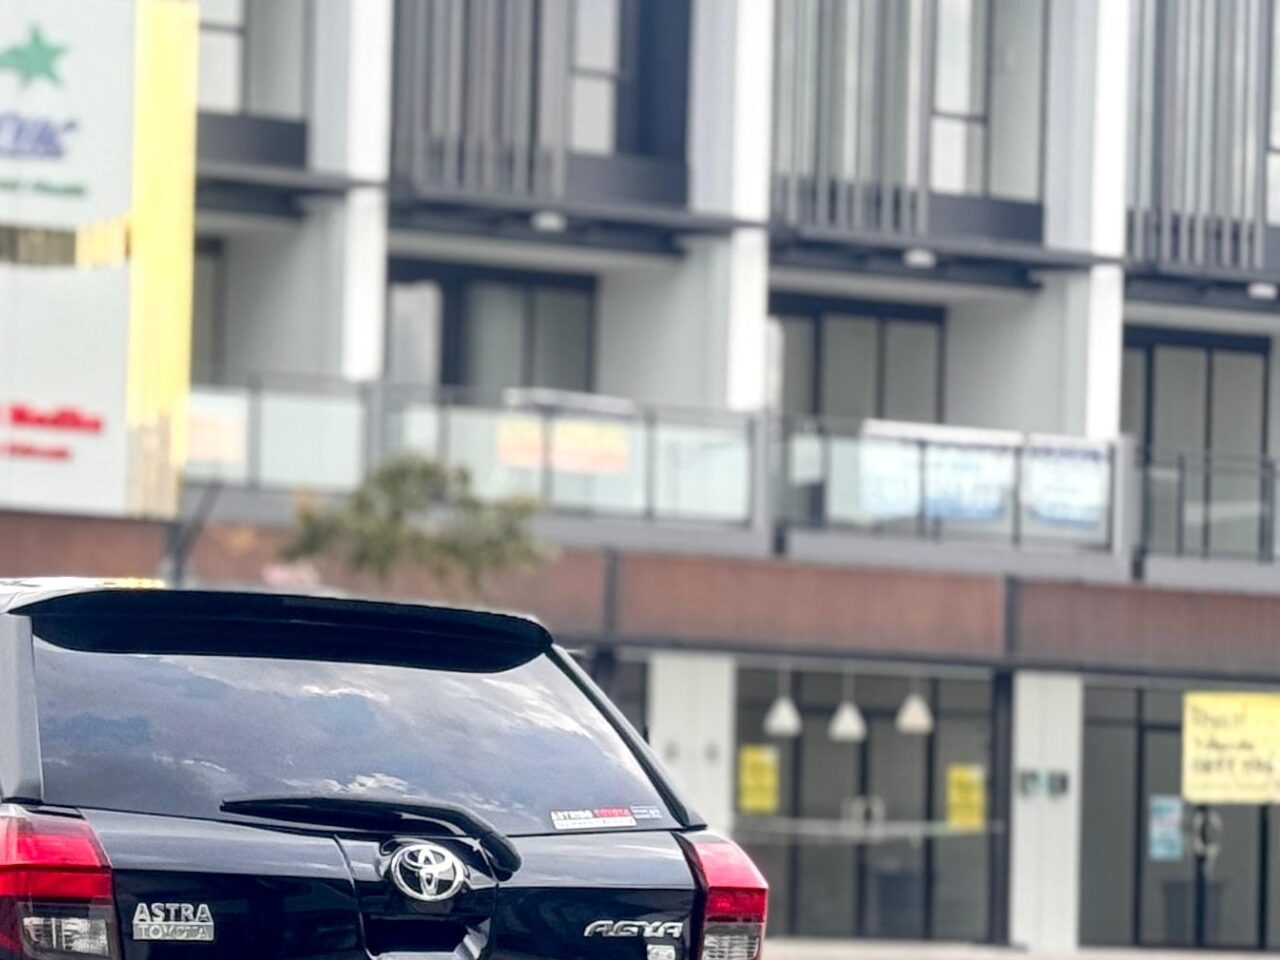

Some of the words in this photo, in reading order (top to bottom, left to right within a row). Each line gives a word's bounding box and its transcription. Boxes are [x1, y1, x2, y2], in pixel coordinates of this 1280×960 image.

[133, 902, 214, 923] ASTRA
[136, 923, 213, 940] TOYOTA
[584, 920, 683, 937] AGYA
